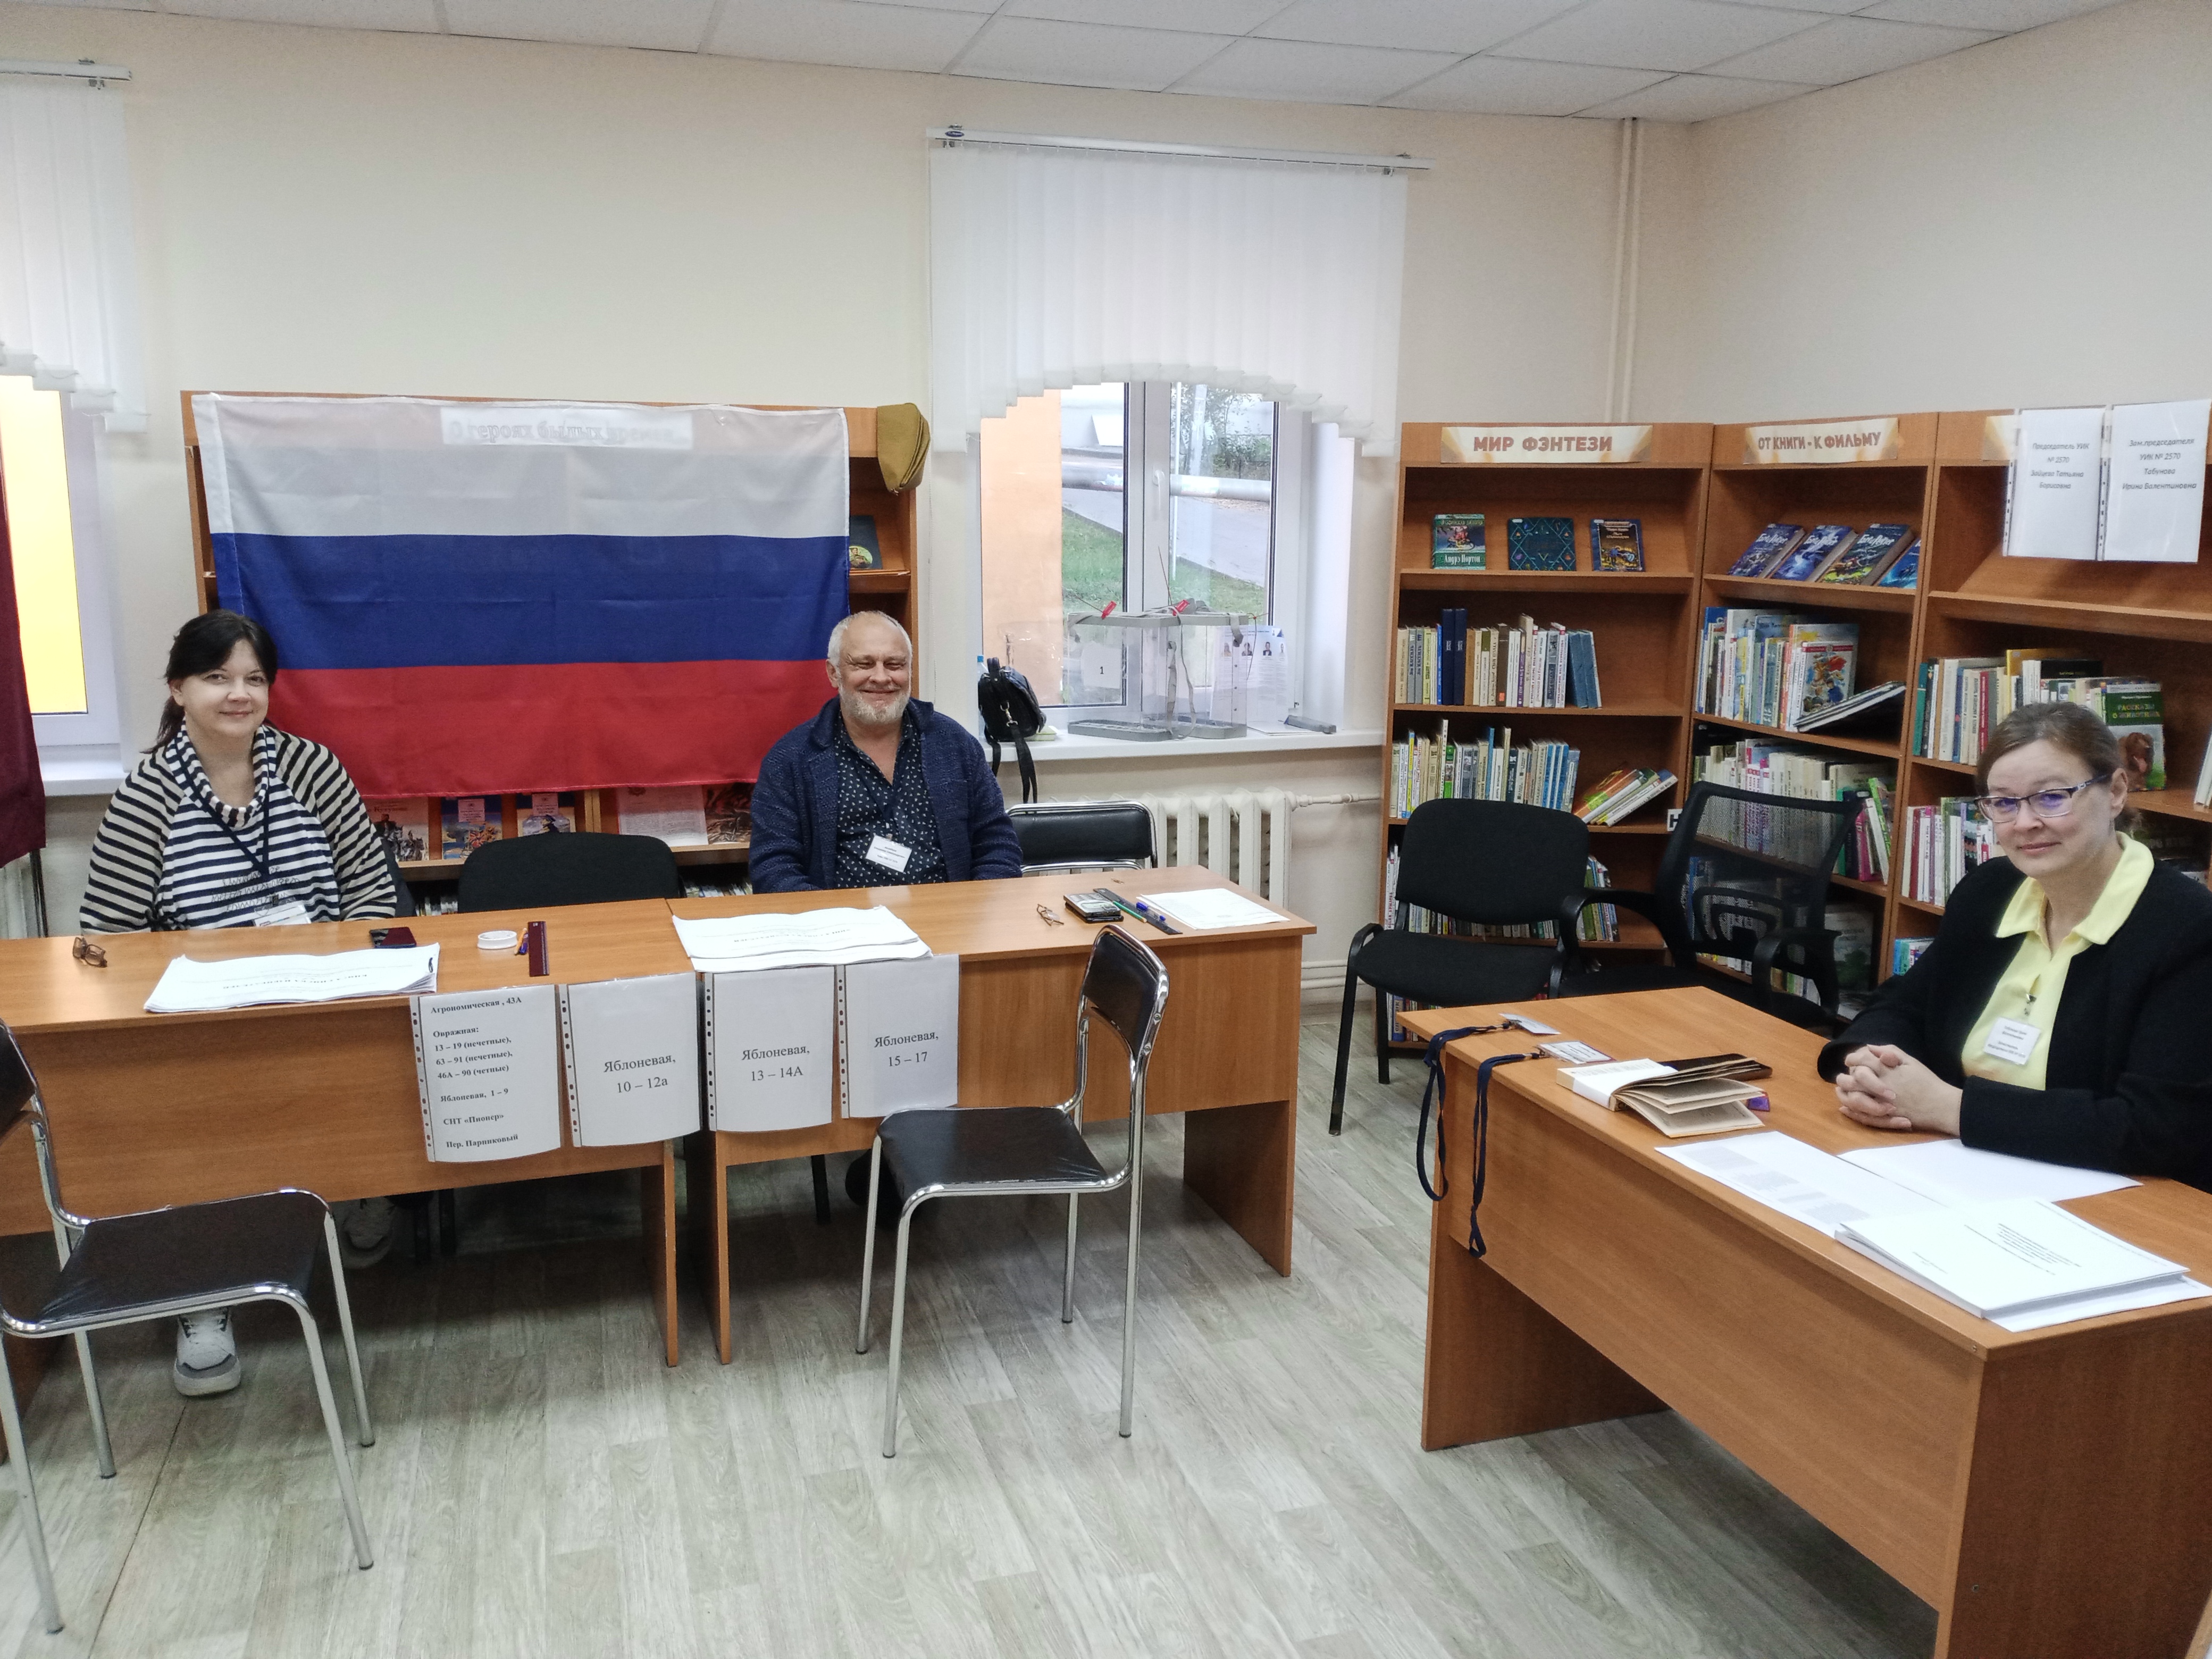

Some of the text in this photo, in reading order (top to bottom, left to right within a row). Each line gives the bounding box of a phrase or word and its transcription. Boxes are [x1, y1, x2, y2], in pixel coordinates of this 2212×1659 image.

[1473, 437, 1612, 451] МИР ФЭНТЕЗИ
[1758, 437, 1771, 450] ОТ
[1773, 436, 1806, 450] КНИГИ
[1814, 436, 1823, 449] К
[1824, 431, 1881, 449] ФИЛЬМУ
[1462, 554, 1480, 565] Нортон
[431, 1000, 500, 1014] Агрономическая
[433, 1027, 479, 1038] Овражная:
[464, 1036, 512, 1049] (нечетные),
[874, 1032, 939, 1048] Яблоневая,
[465, 1051, 513, 1063] (нечетные),
[741, 1046, 810, 1060] Яблоневая,
[889, 1055, 901, 1067] 15
[916, 1051, 927, 1062] 17
[473, 1065, 509, 1076] (четные)
[604, 1055, 676, 1073] Яблоневая,
[752, 1070, 764, 1081] 13
[781, 1066, 803, 1078] 14А
[617, 1081, 631, 1093] 10
[648, 1077, 668, 1088] 12а
[440, 1093, 487, 1102] Яблоневая,
[464, 1115, 504, 1124] «Пионер»
[466, 1134, 518, 1147] Парниковый
